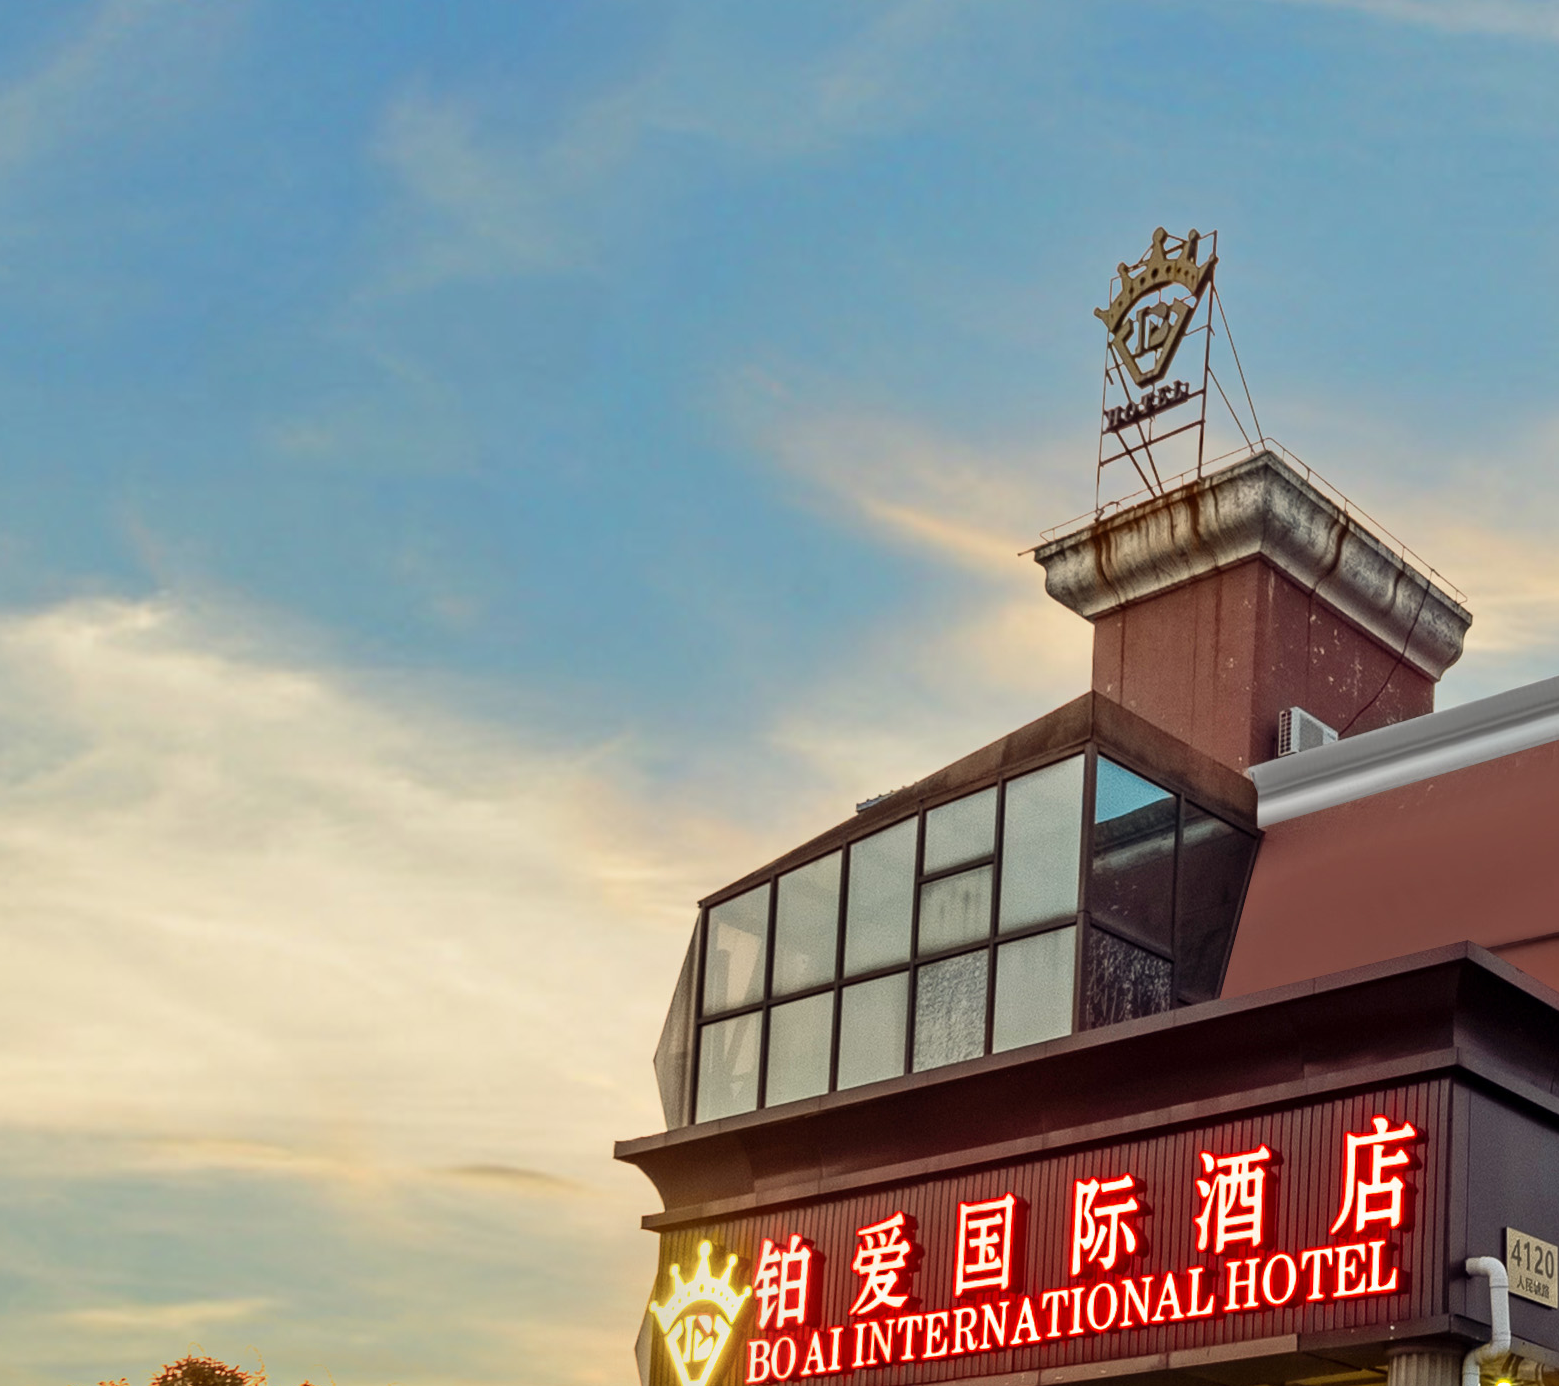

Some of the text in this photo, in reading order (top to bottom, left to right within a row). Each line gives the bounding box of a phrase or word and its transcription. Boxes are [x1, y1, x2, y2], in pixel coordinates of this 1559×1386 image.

[1105, 380, 1189, 428] HOTEL
[753, 1114, 1417, 1330] 铂爱国际酒店
[1511, 1239, 1554, 1279] 4120
[851, 1266, 1216, 1368] INTERNATIONAL
[1223, 1239, 1398, 1312] HOTEL
